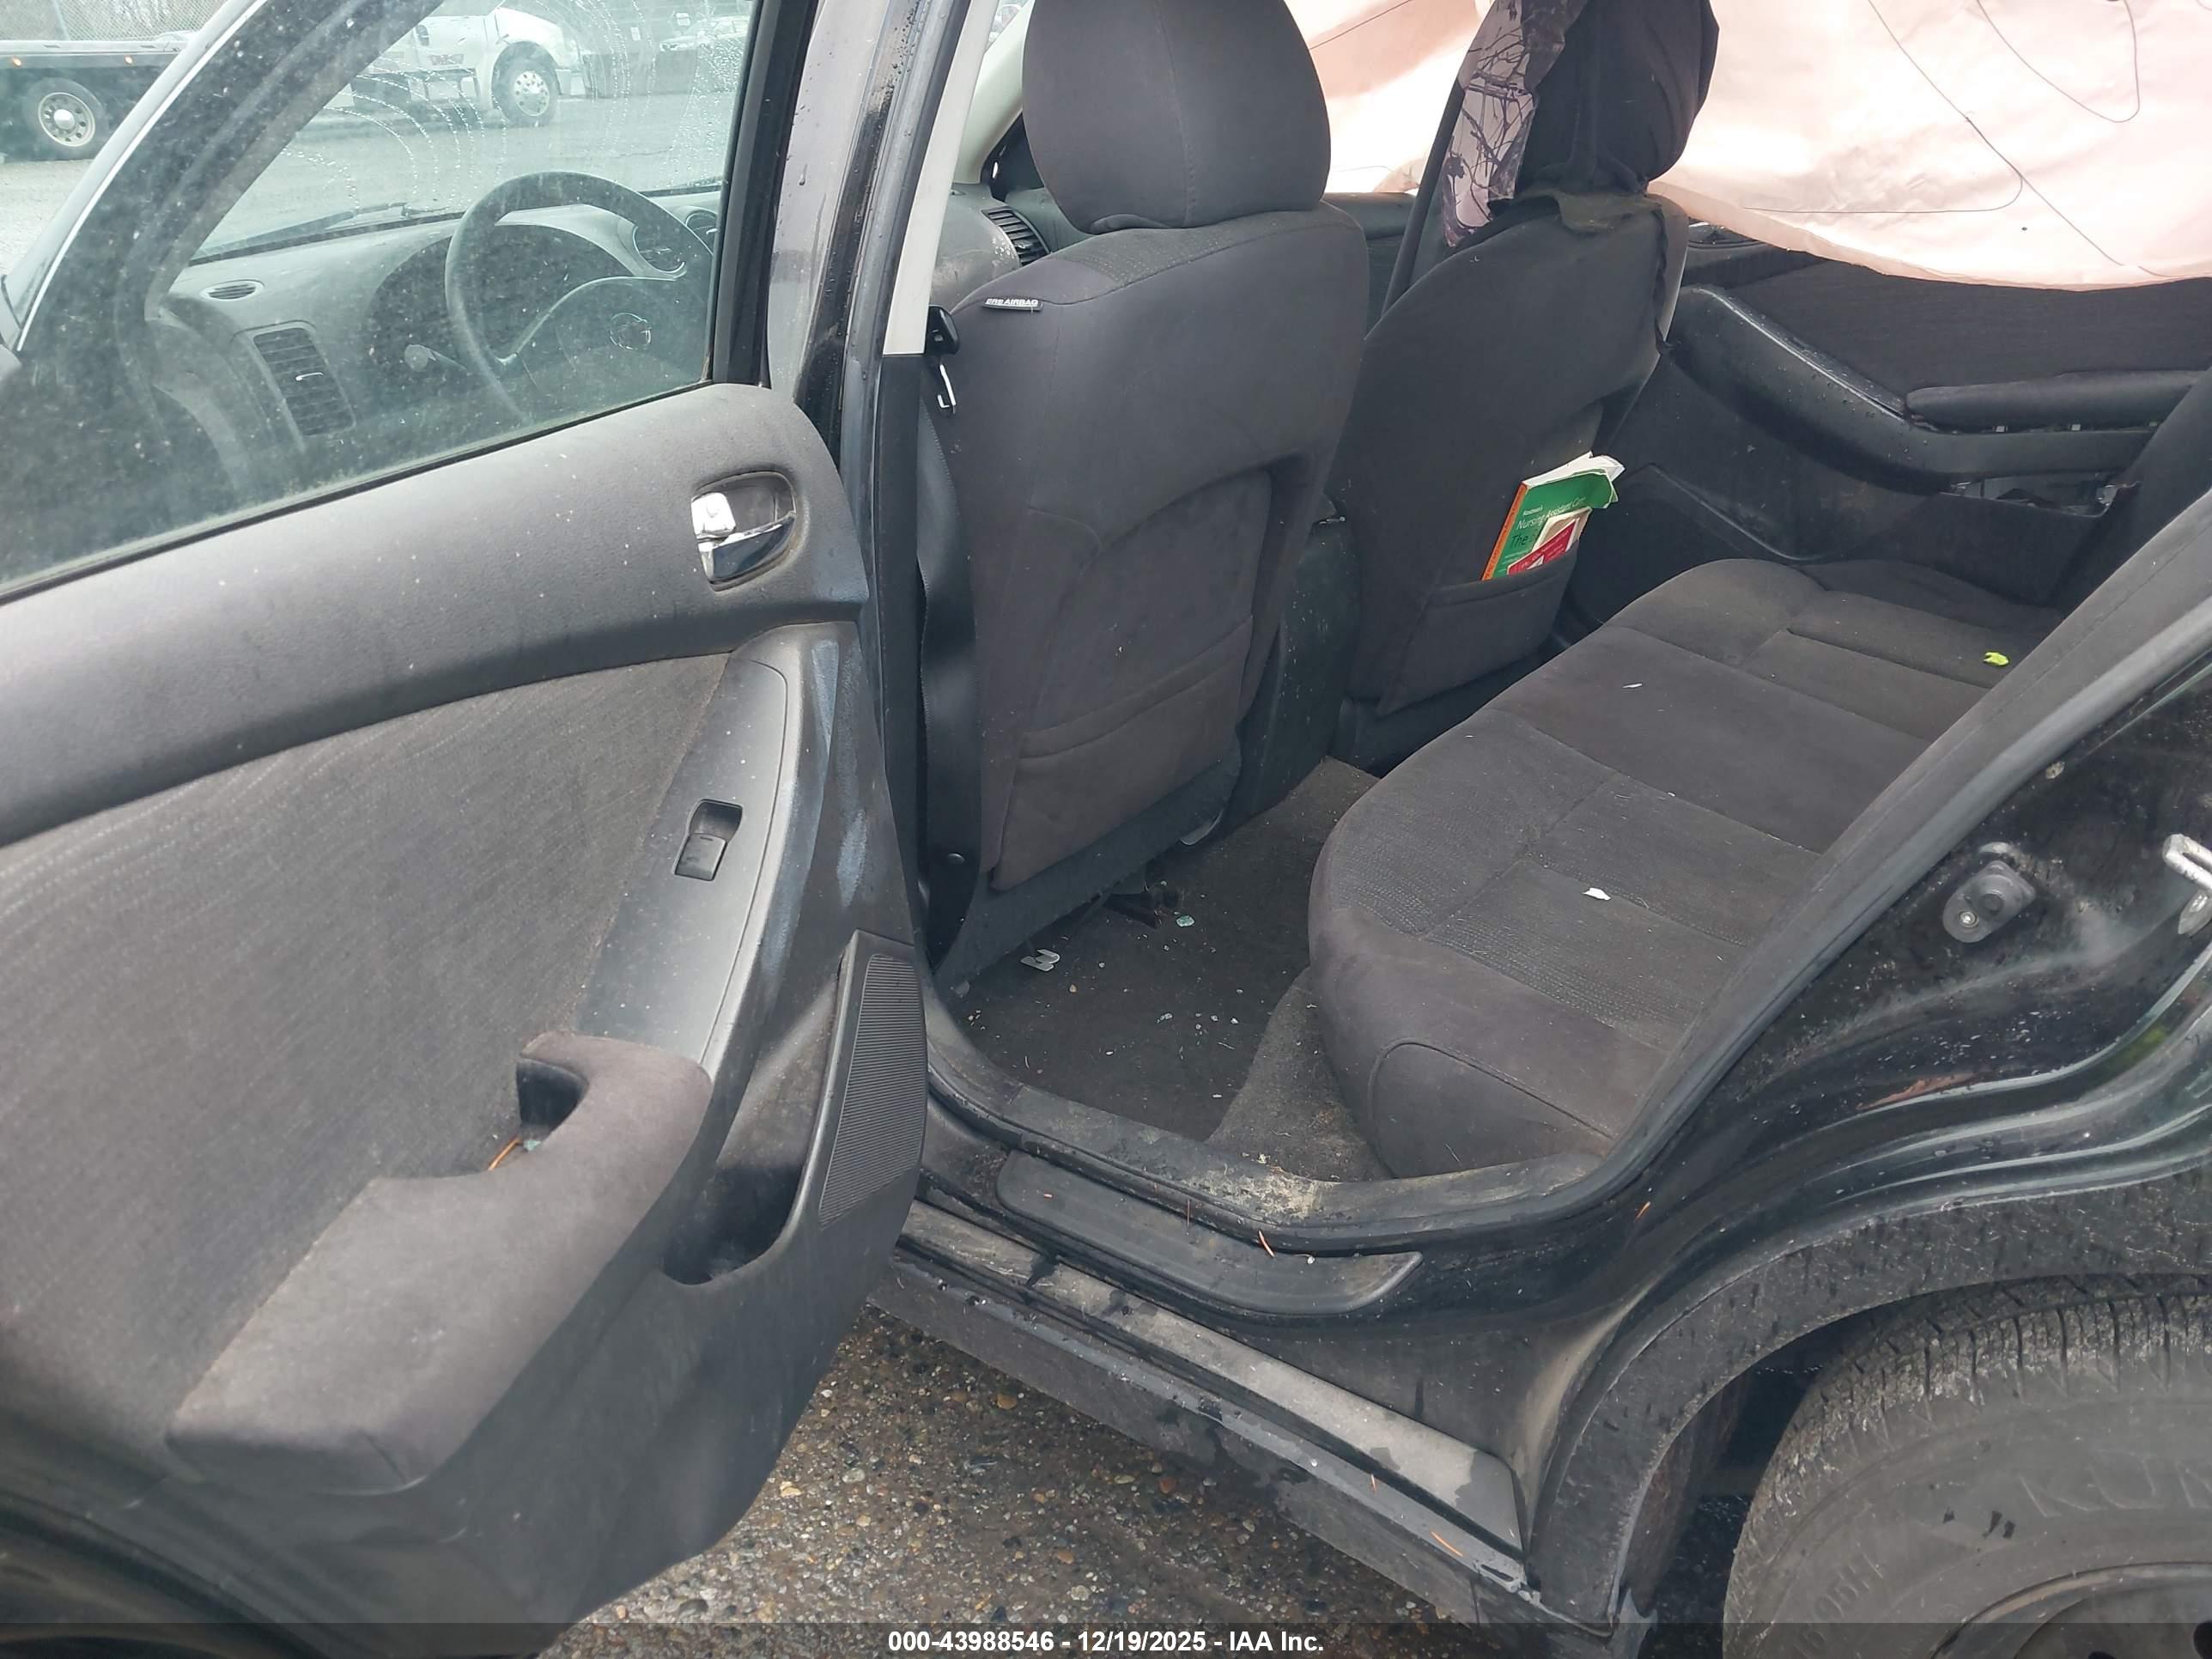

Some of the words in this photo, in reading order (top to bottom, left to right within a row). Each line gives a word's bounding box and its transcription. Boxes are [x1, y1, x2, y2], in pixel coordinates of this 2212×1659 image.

[1004, 298, 1039, 307] AIRBAG
[1516, 515, 1545, 530] Nursing
[1510, 532, 1528, 547] The
